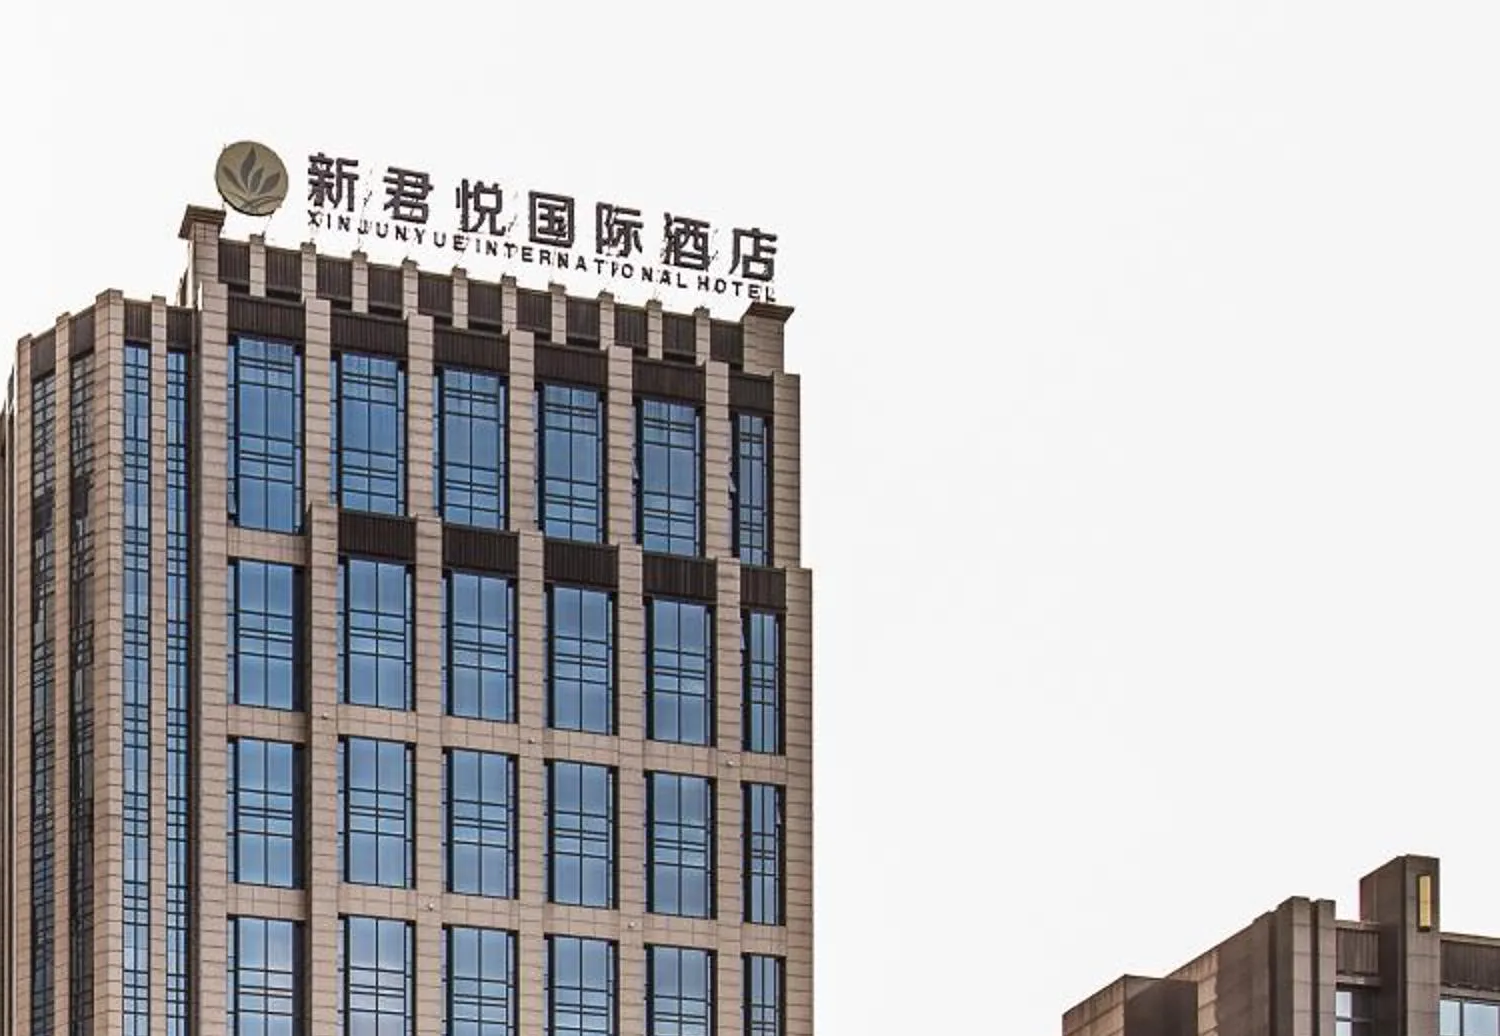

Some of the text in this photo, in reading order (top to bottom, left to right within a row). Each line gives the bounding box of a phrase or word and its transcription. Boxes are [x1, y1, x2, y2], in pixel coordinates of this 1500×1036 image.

[308, 152, 777, 281] 新君悦国际酒店
[698, 277, 777, 302] HOTEL
